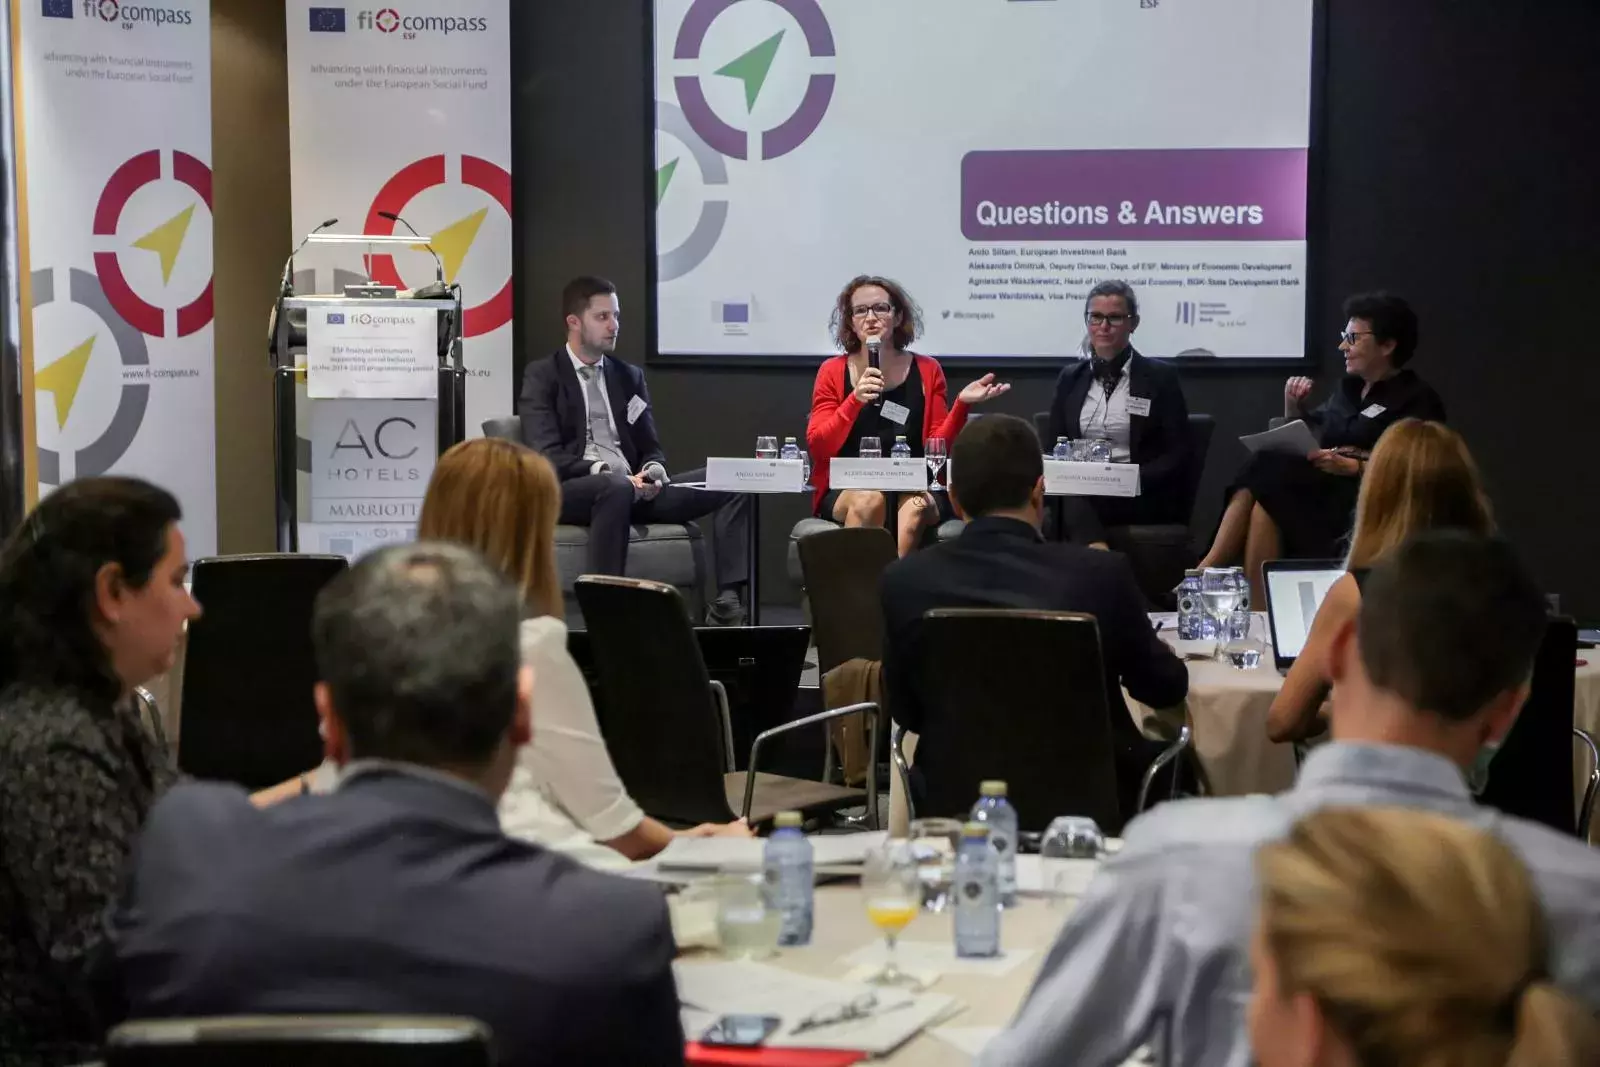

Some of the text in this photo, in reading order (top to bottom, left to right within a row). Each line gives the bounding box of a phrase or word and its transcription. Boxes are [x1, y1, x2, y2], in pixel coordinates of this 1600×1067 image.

[89, 53, 108, 64] with
[108, 54, 144, 66] financial
[145, 57, 193, 70] instruments
[106, 69, 146, 83] European
[149, 71, 171, 82] Social
[172, 71, 193, 83] Fund
[311, 64, 488, 77] advancing with financial instruments
[334, 79, 488, 91] under the European Social Fund
[976, 200, 1263, 227] Questions & Answers
[1020, 247, 1058, 257] European
[1060, 247, 1104, 256] Investment
[1106, 247, 1127, 256] Bank
[969, 262, 1012, 271] Aleksandra
[1049, 262, 1075, 272] Deputy
[1132, 262, 1140, 271] of
[1160, 262, 1190, 272] Ministry
[1192, 262, 1200, 271] of
[1202, 262, 1240, 271] Economic
[1242, 262, 1292, 272] Development
[969, 277, 1009, 287] Agnieszka
[1064, 278, 1084, 286] Head
[1085, 277, 1093, 286] of
[1228, 278, 1279, 288] Development
[1281, 278, 1300, 287] Bank
[969, 292, 997, 301] Joanna
[329, 416, 419, 460] AC
[328, 467, 420, 482] HOTELS
[329, 502, 419, 517] MARRIOTT
